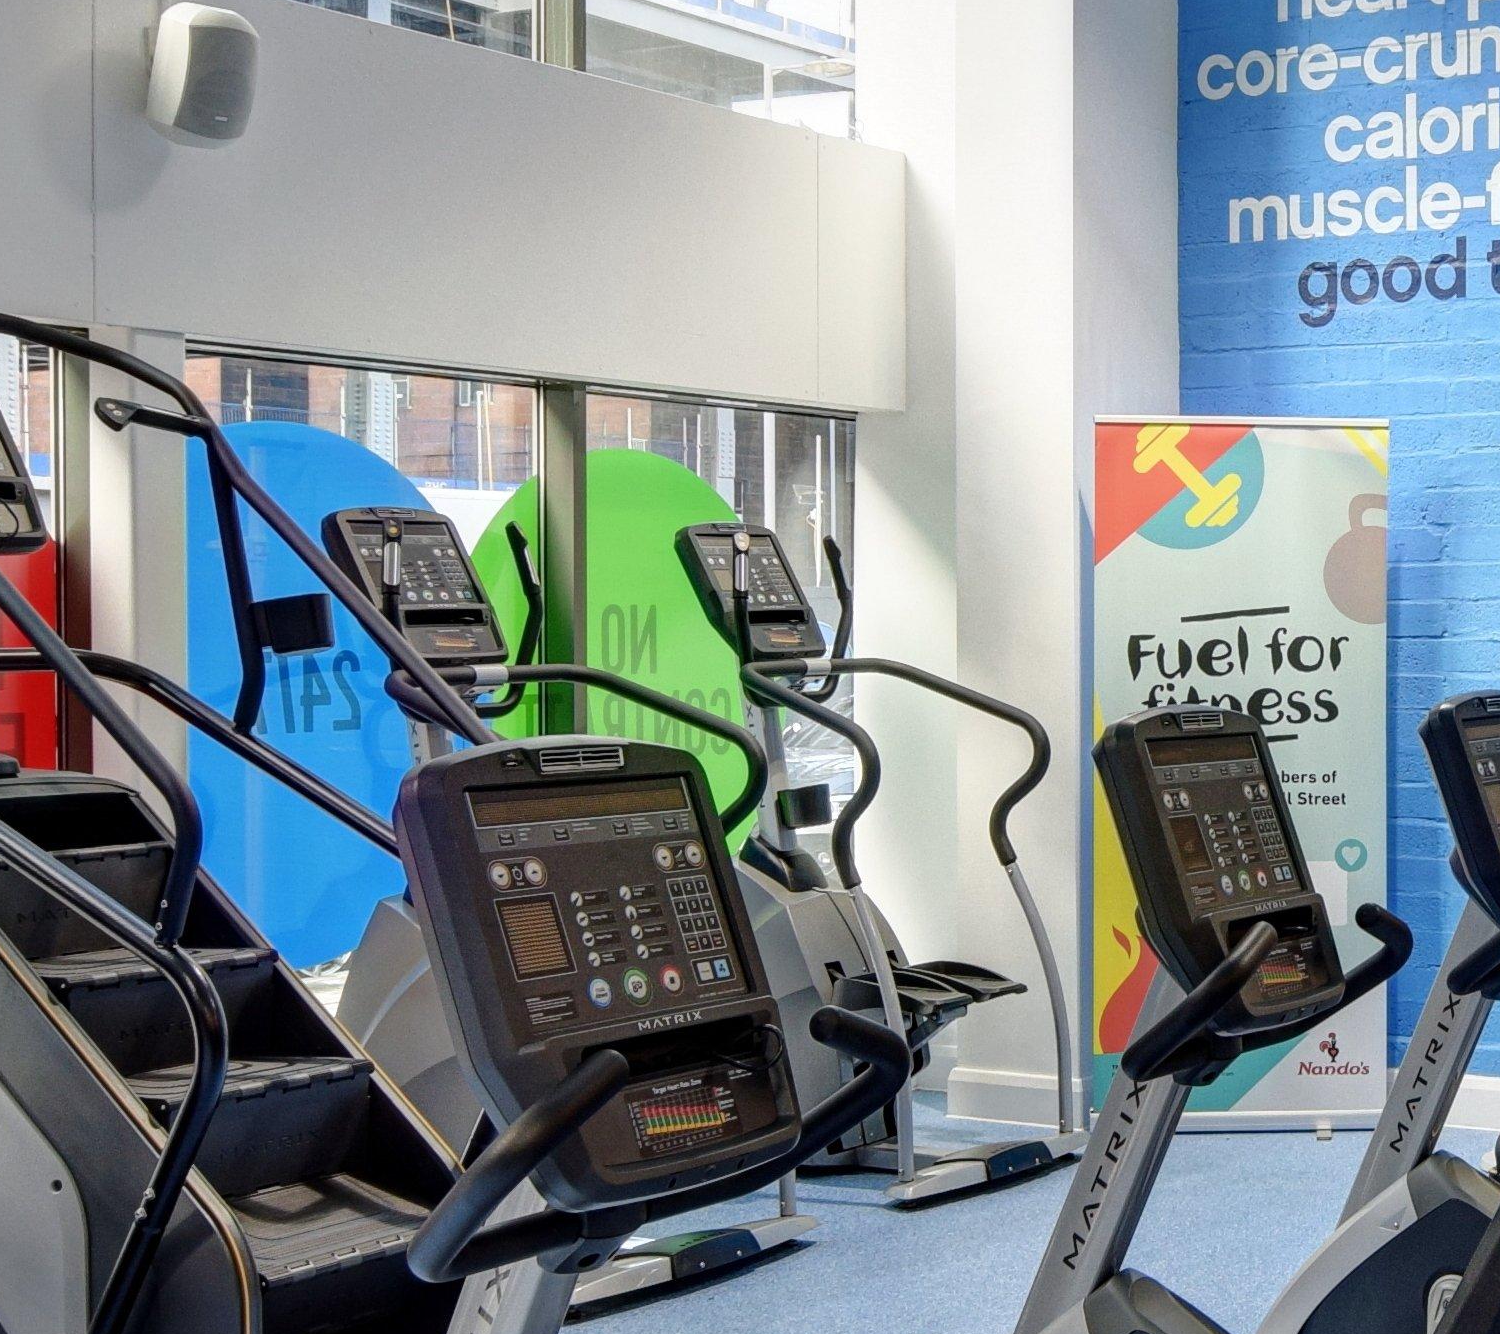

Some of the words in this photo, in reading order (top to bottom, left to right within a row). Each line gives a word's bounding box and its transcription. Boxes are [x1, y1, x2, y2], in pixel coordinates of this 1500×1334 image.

[1298, 237, 1468, 328] good
[1127, 625, 1249, 682] Fuel
[1264, 627, 1350, 675] for
[1281, 770, 1316, 784] bers
[1322, 770, 1337, 784] of
[1297, 792, 1346, 806] Street
[1254, 899, 1288, 914] MATRIX
[637, 1010, 703, 1032] MATRIX
[1297, 1061, 1370, 1076] Nando's
[1388, 992, 1462, 1154] MATRIX
[1063, 1079, 1149, 1271] MATRIX
